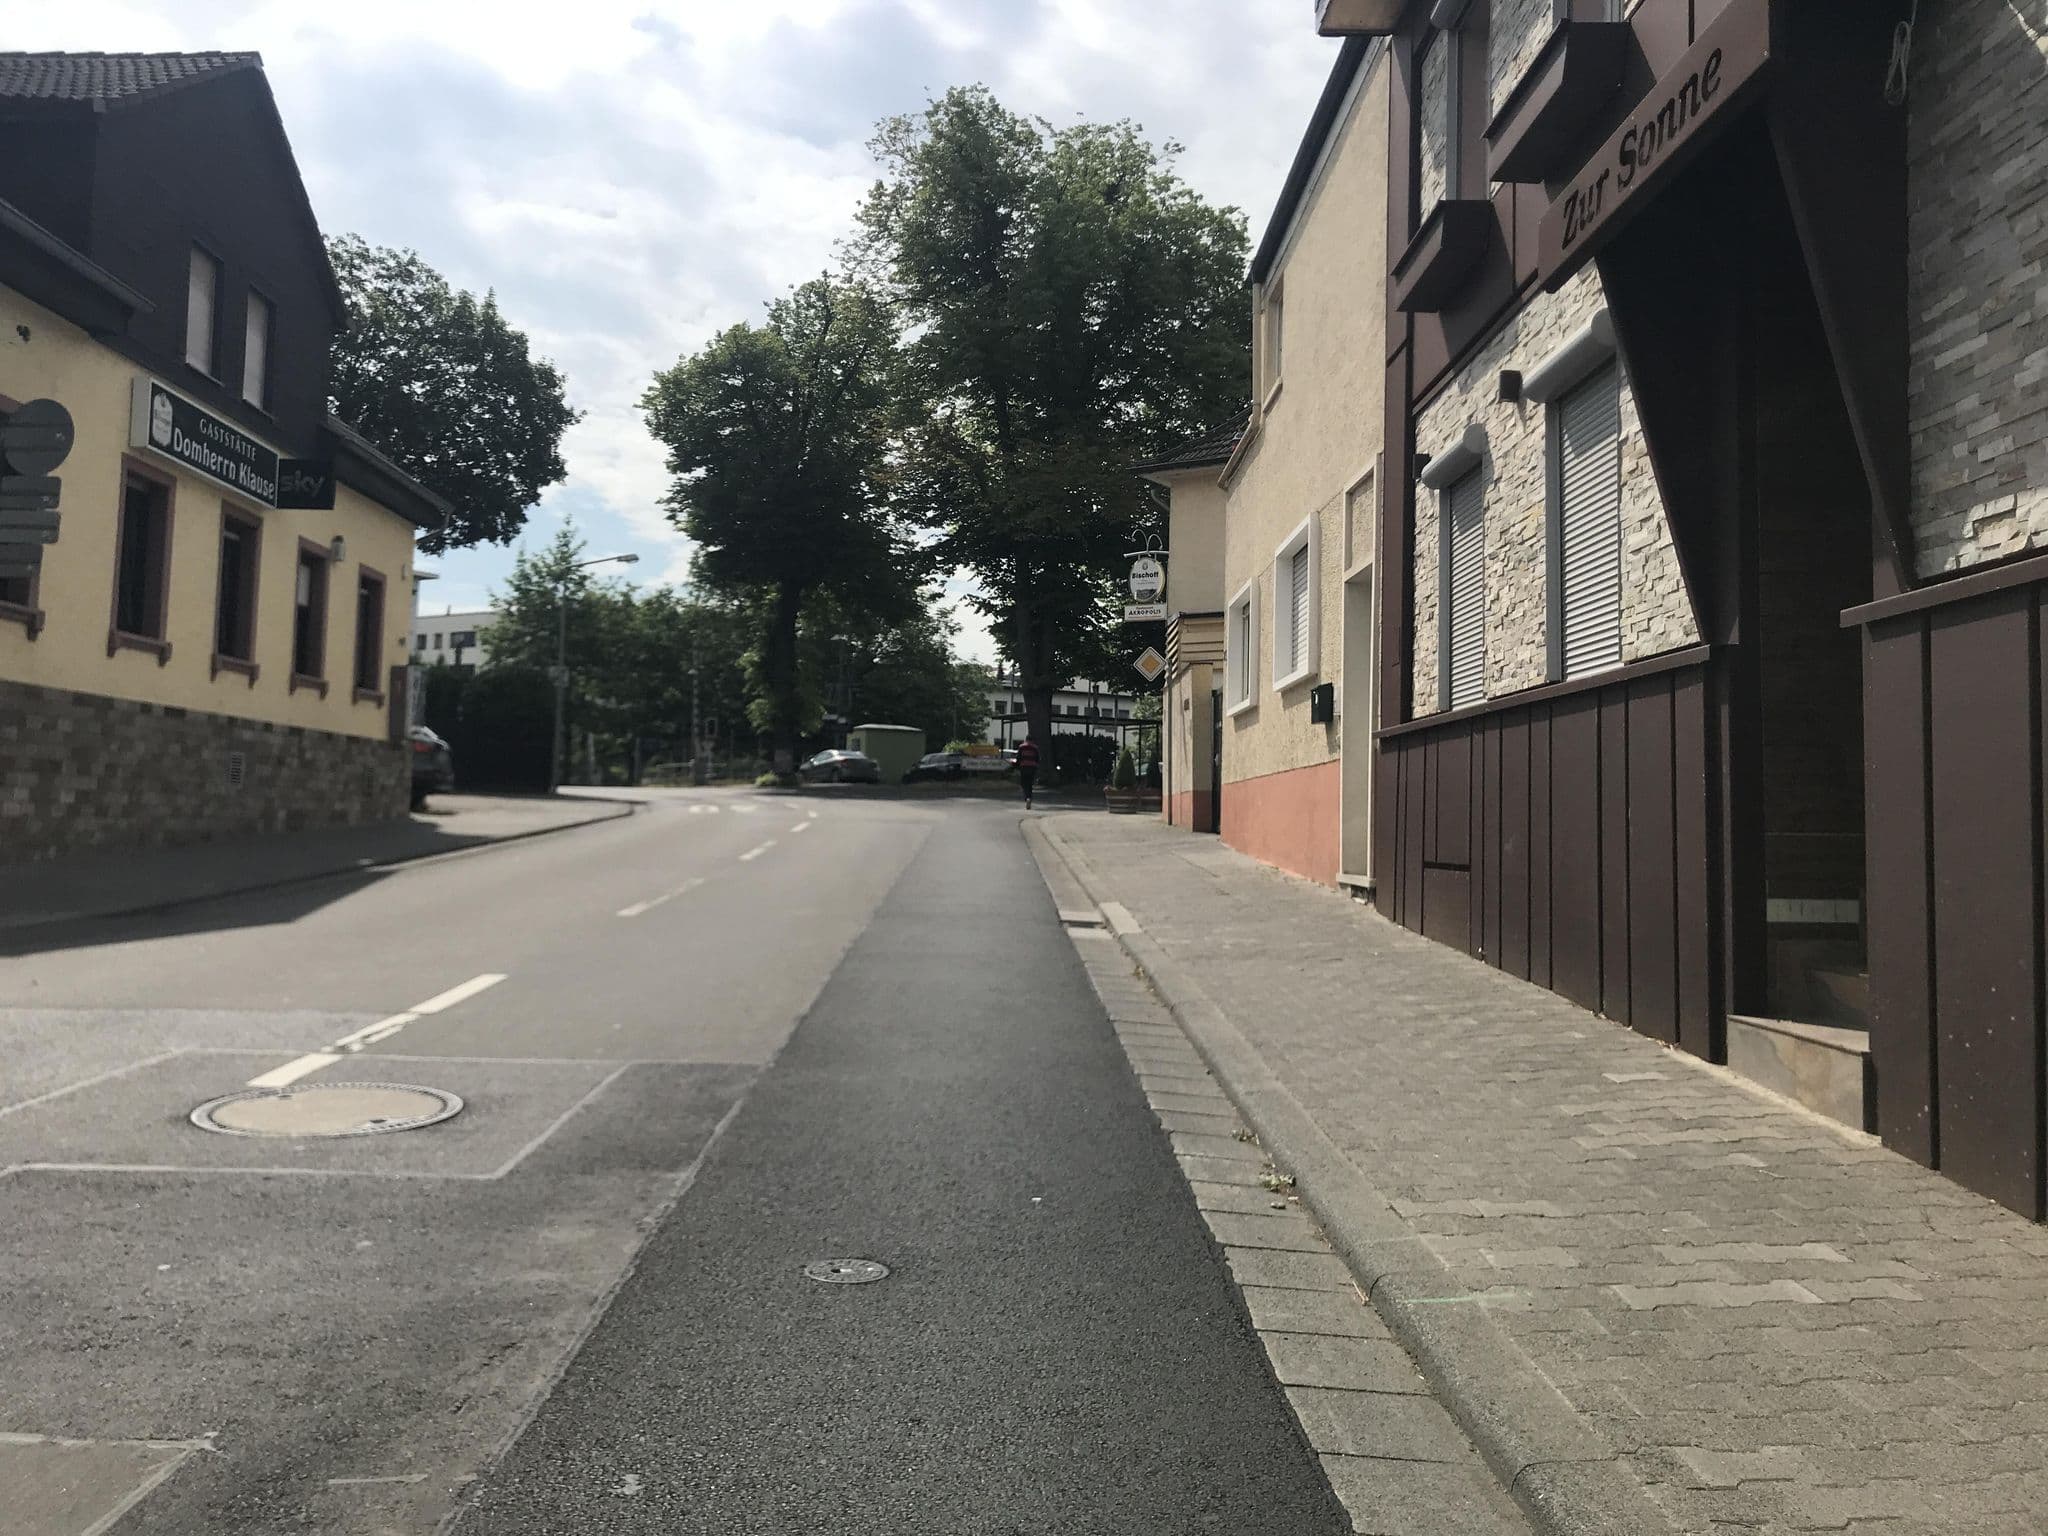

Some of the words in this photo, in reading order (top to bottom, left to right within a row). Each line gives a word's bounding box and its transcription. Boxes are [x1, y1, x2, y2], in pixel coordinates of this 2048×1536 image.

[1561, 167, 1610, 251] Zur
[1617, 47, 1723, 193] Sonne
[173, 427, 236, 481] Domherrn
[239, 462, 276, 500] Klause
[199, 418, 257, 462] GASTSTÄTTE
[1131, 571, 1159, 579] Bischoff
